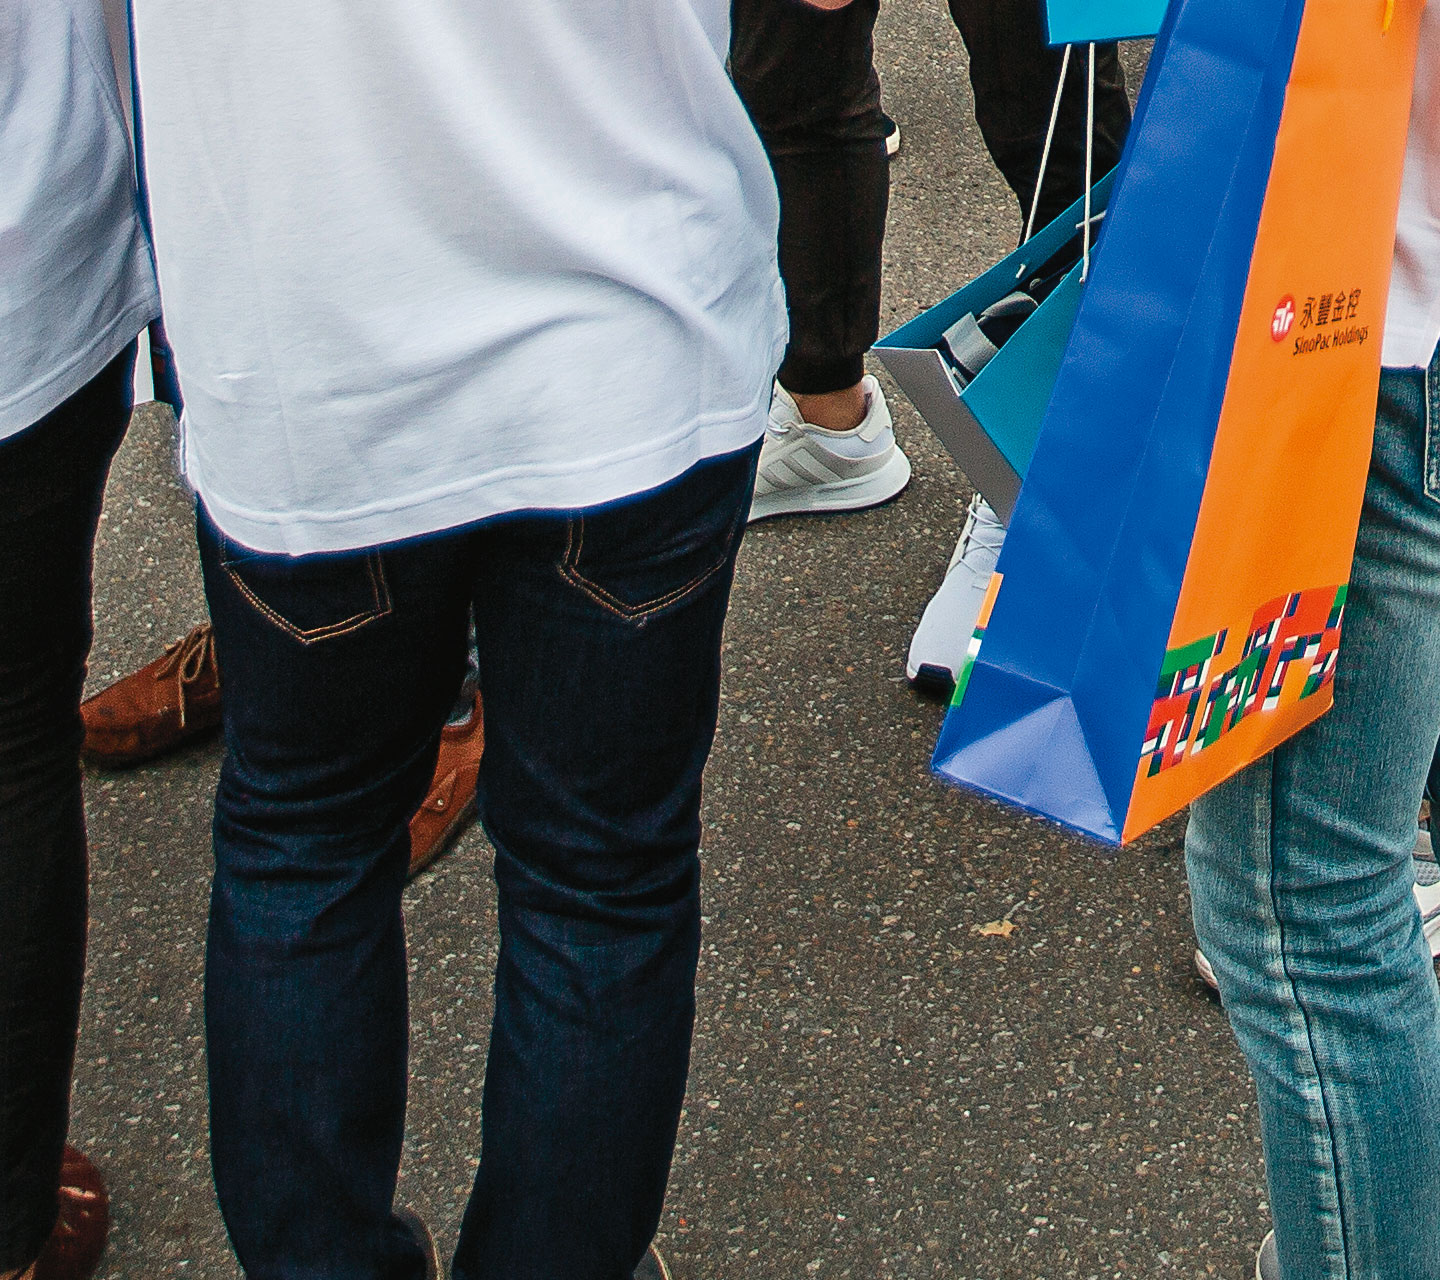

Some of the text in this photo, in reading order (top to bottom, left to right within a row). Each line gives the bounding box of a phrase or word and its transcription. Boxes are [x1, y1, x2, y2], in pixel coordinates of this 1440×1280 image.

[1302, 287, 1361, 330] 永豐金控
[1293, 326, 1369, 356] SinoPac Holdings
